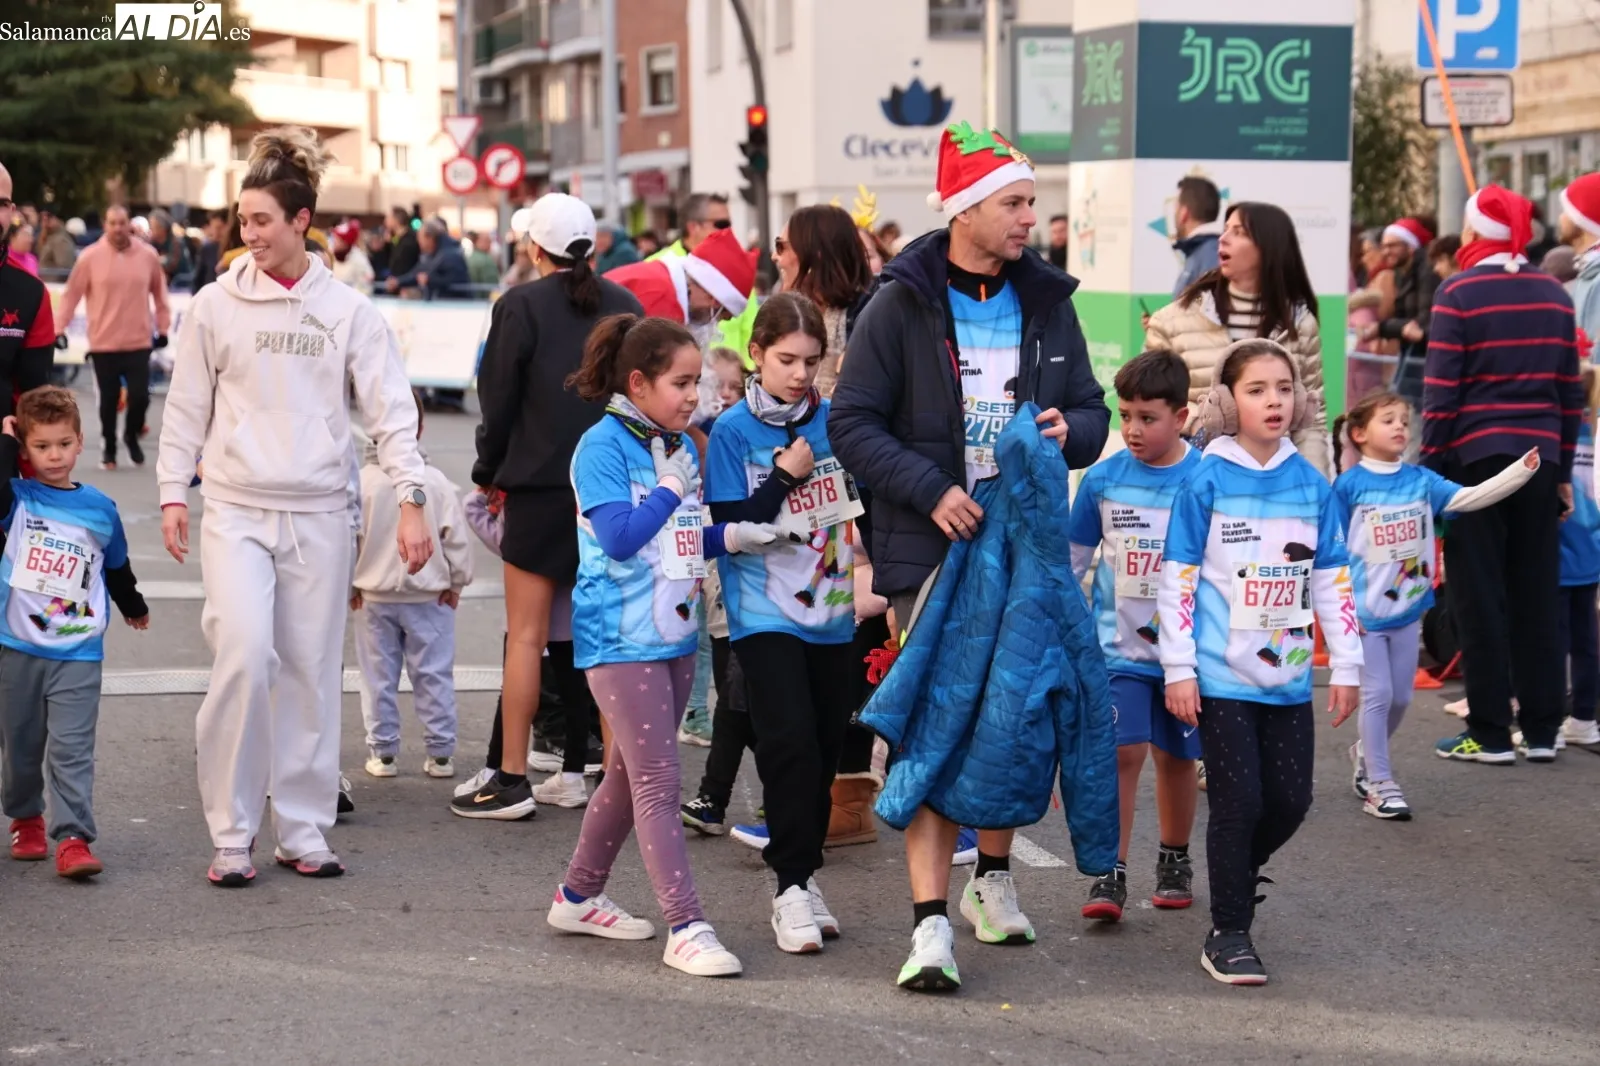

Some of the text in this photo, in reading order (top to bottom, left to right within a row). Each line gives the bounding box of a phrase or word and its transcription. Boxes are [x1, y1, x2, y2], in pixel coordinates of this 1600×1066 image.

[1437, 0, 1501, 60] P
[844, 133, 939, 160] Clecev
[255, 331, 325, 357] PUMA
[976, 401, 1015, 413] SETE
[964, 414, 1012, 442] 279
[786, 476, 838, 514] 6578
[1382, 507, 1423, 522] SETEL
[1373, 519, 1418, 546] 6938
[42, 536, 87, 558] SETEL
[25, 546, 79, 580] 6547
[1126, 551, 1163, 577] 674
[1258, 565, 1305, 578] SETEL
[1244, 579, 1297, 607] 6723
